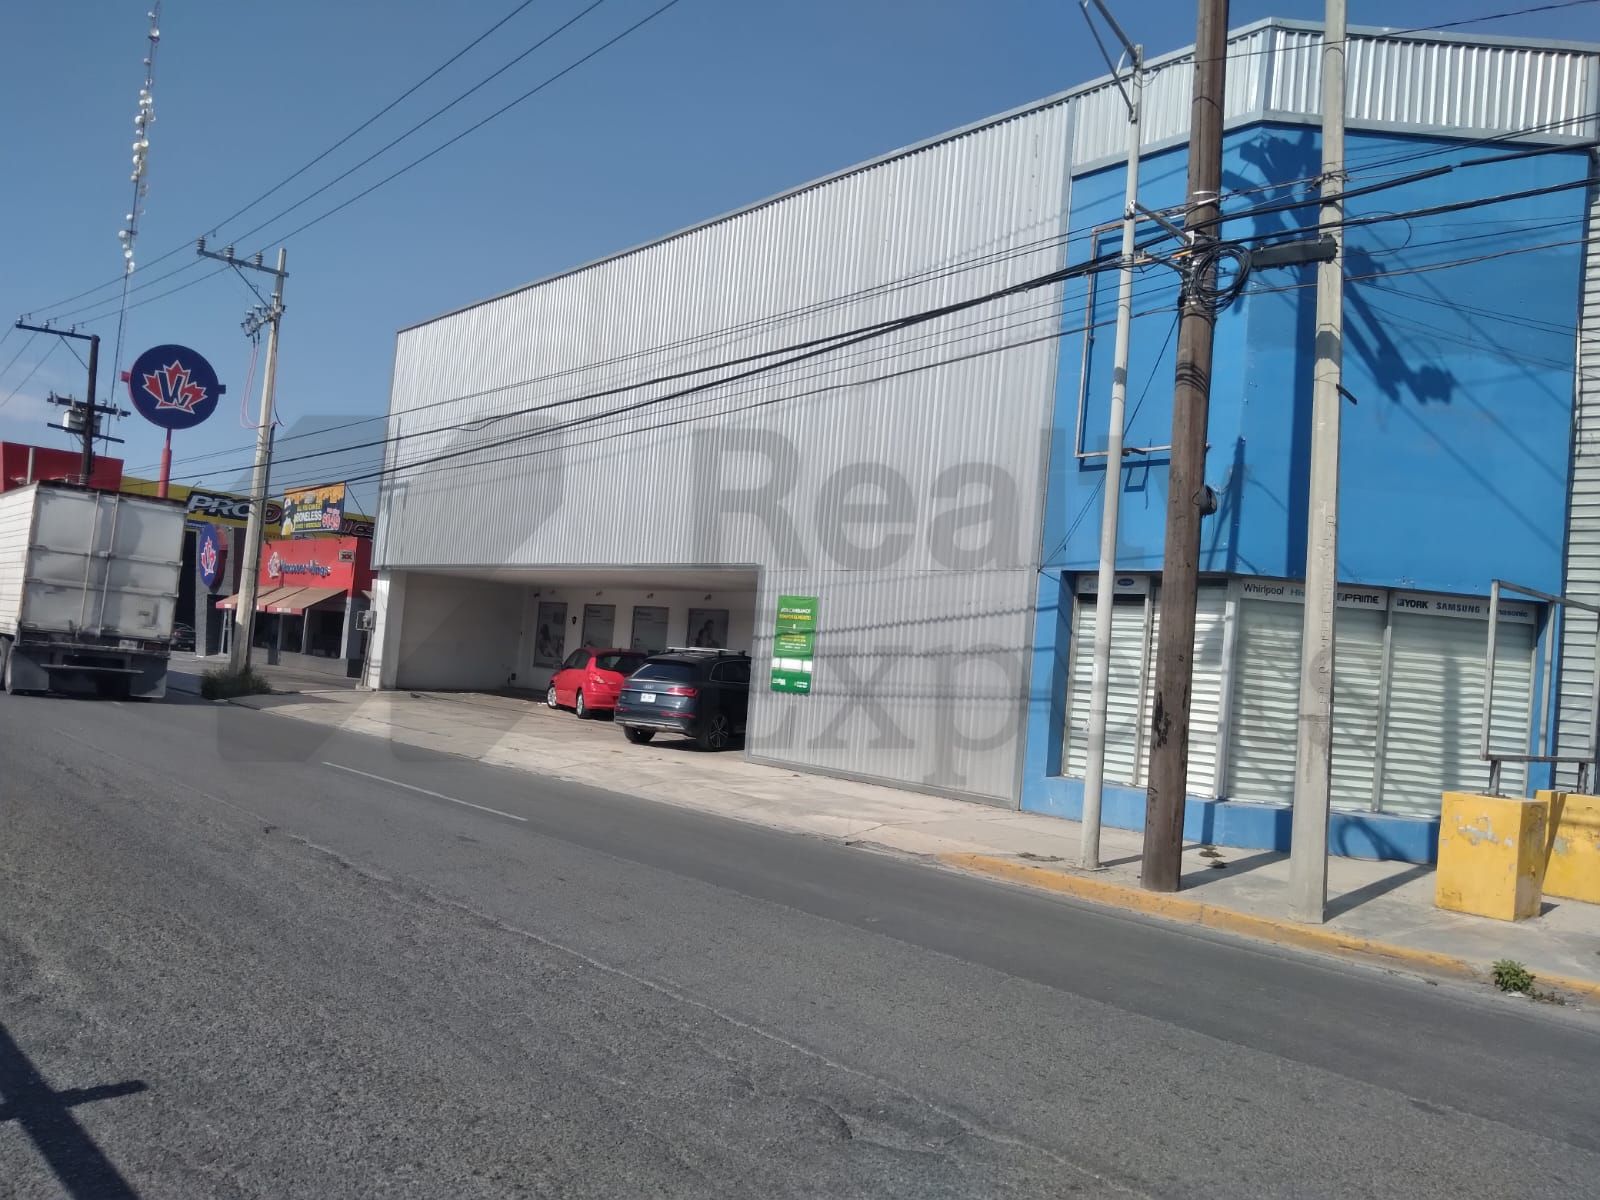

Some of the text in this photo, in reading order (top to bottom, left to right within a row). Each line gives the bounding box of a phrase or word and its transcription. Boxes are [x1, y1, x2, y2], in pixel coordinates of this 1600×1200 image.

[1243, 582, 1285, 597] Whirlpool
[1344, 593, 1380, 604] PRIME
[1404, 599, 1529, 619] YORK SAMSUNG Pnasonic
